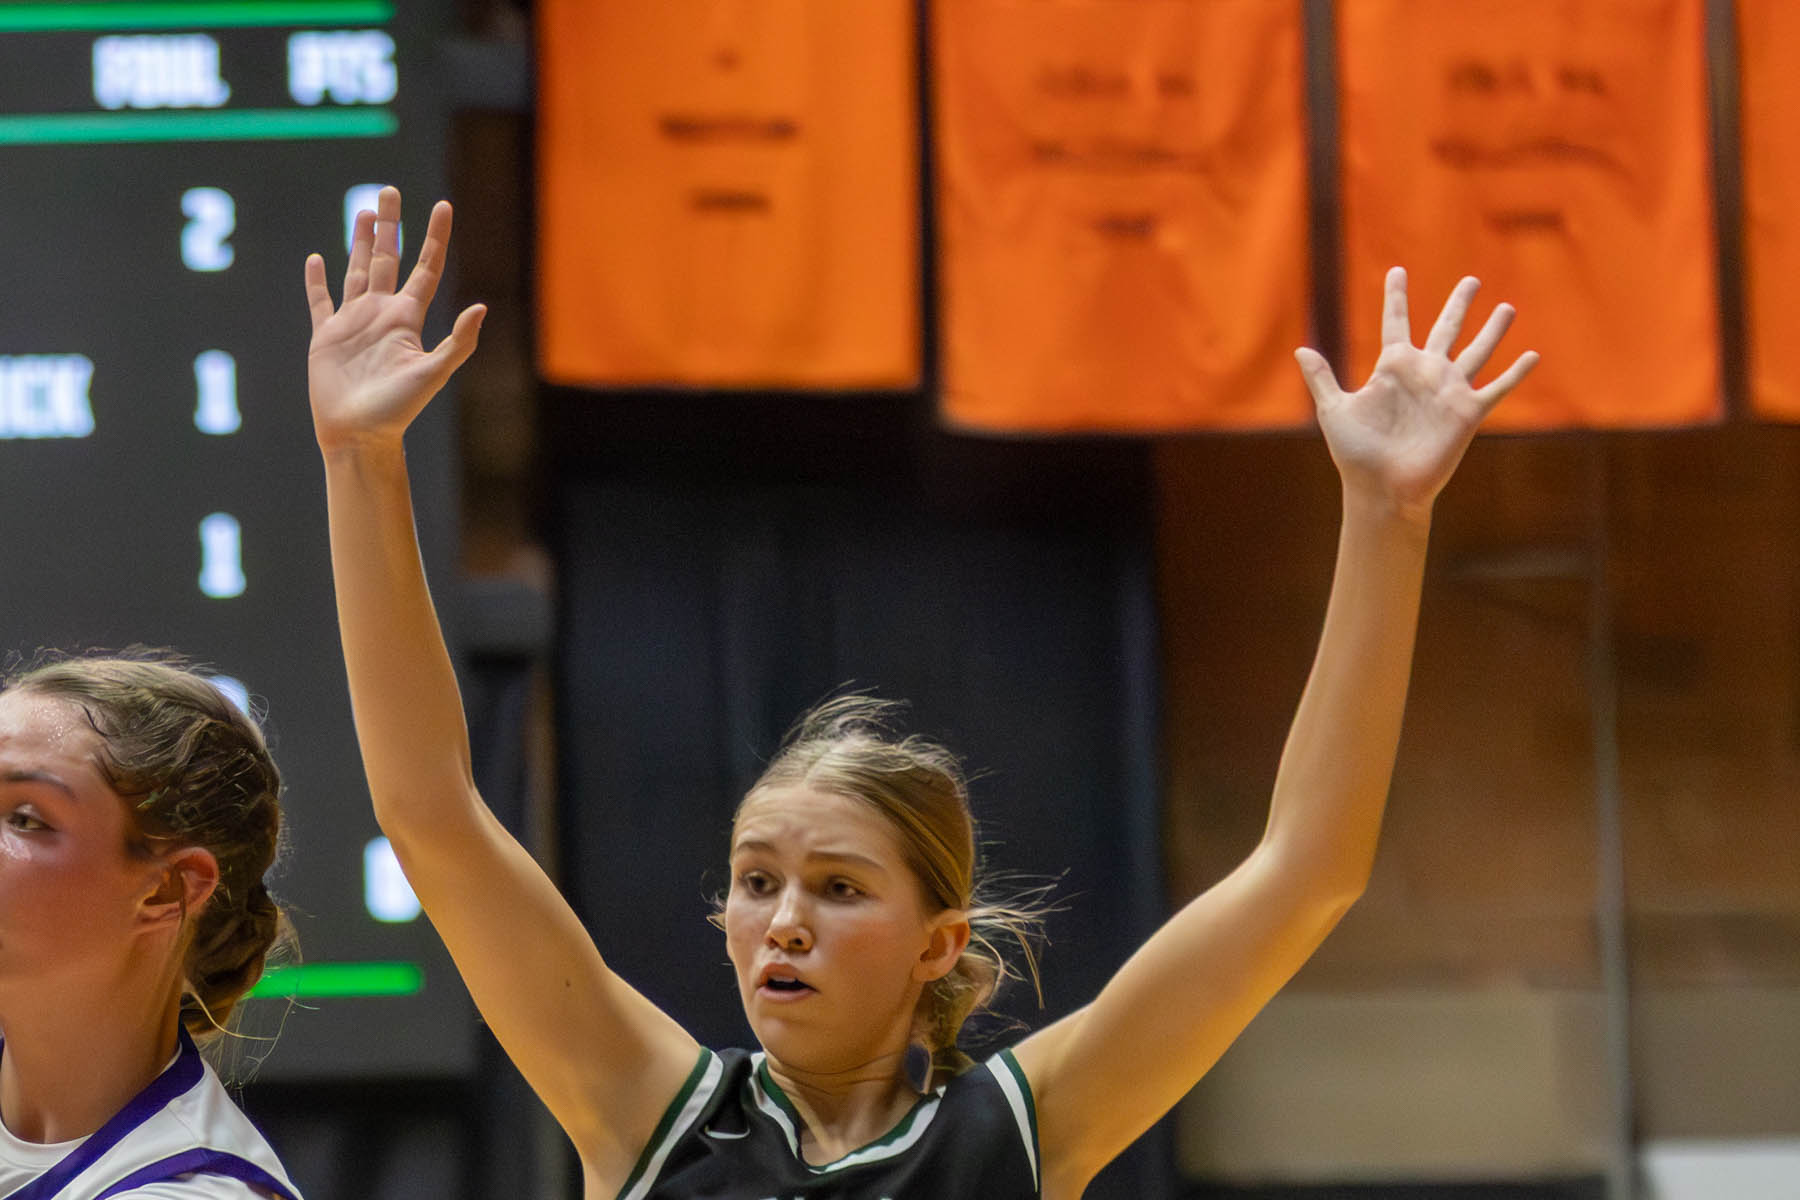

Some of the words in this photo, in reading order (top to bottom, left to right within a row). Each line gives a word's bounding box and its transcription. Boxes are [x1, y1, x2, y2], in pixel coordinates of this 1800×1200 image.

[93, 35, 230, 108] FOUL
[288, 32, 397, 104] PTS
[183, 189, 235, 271] 2
[196, 352, 241, 433] 1
[201, 513, 245, 597] 1
